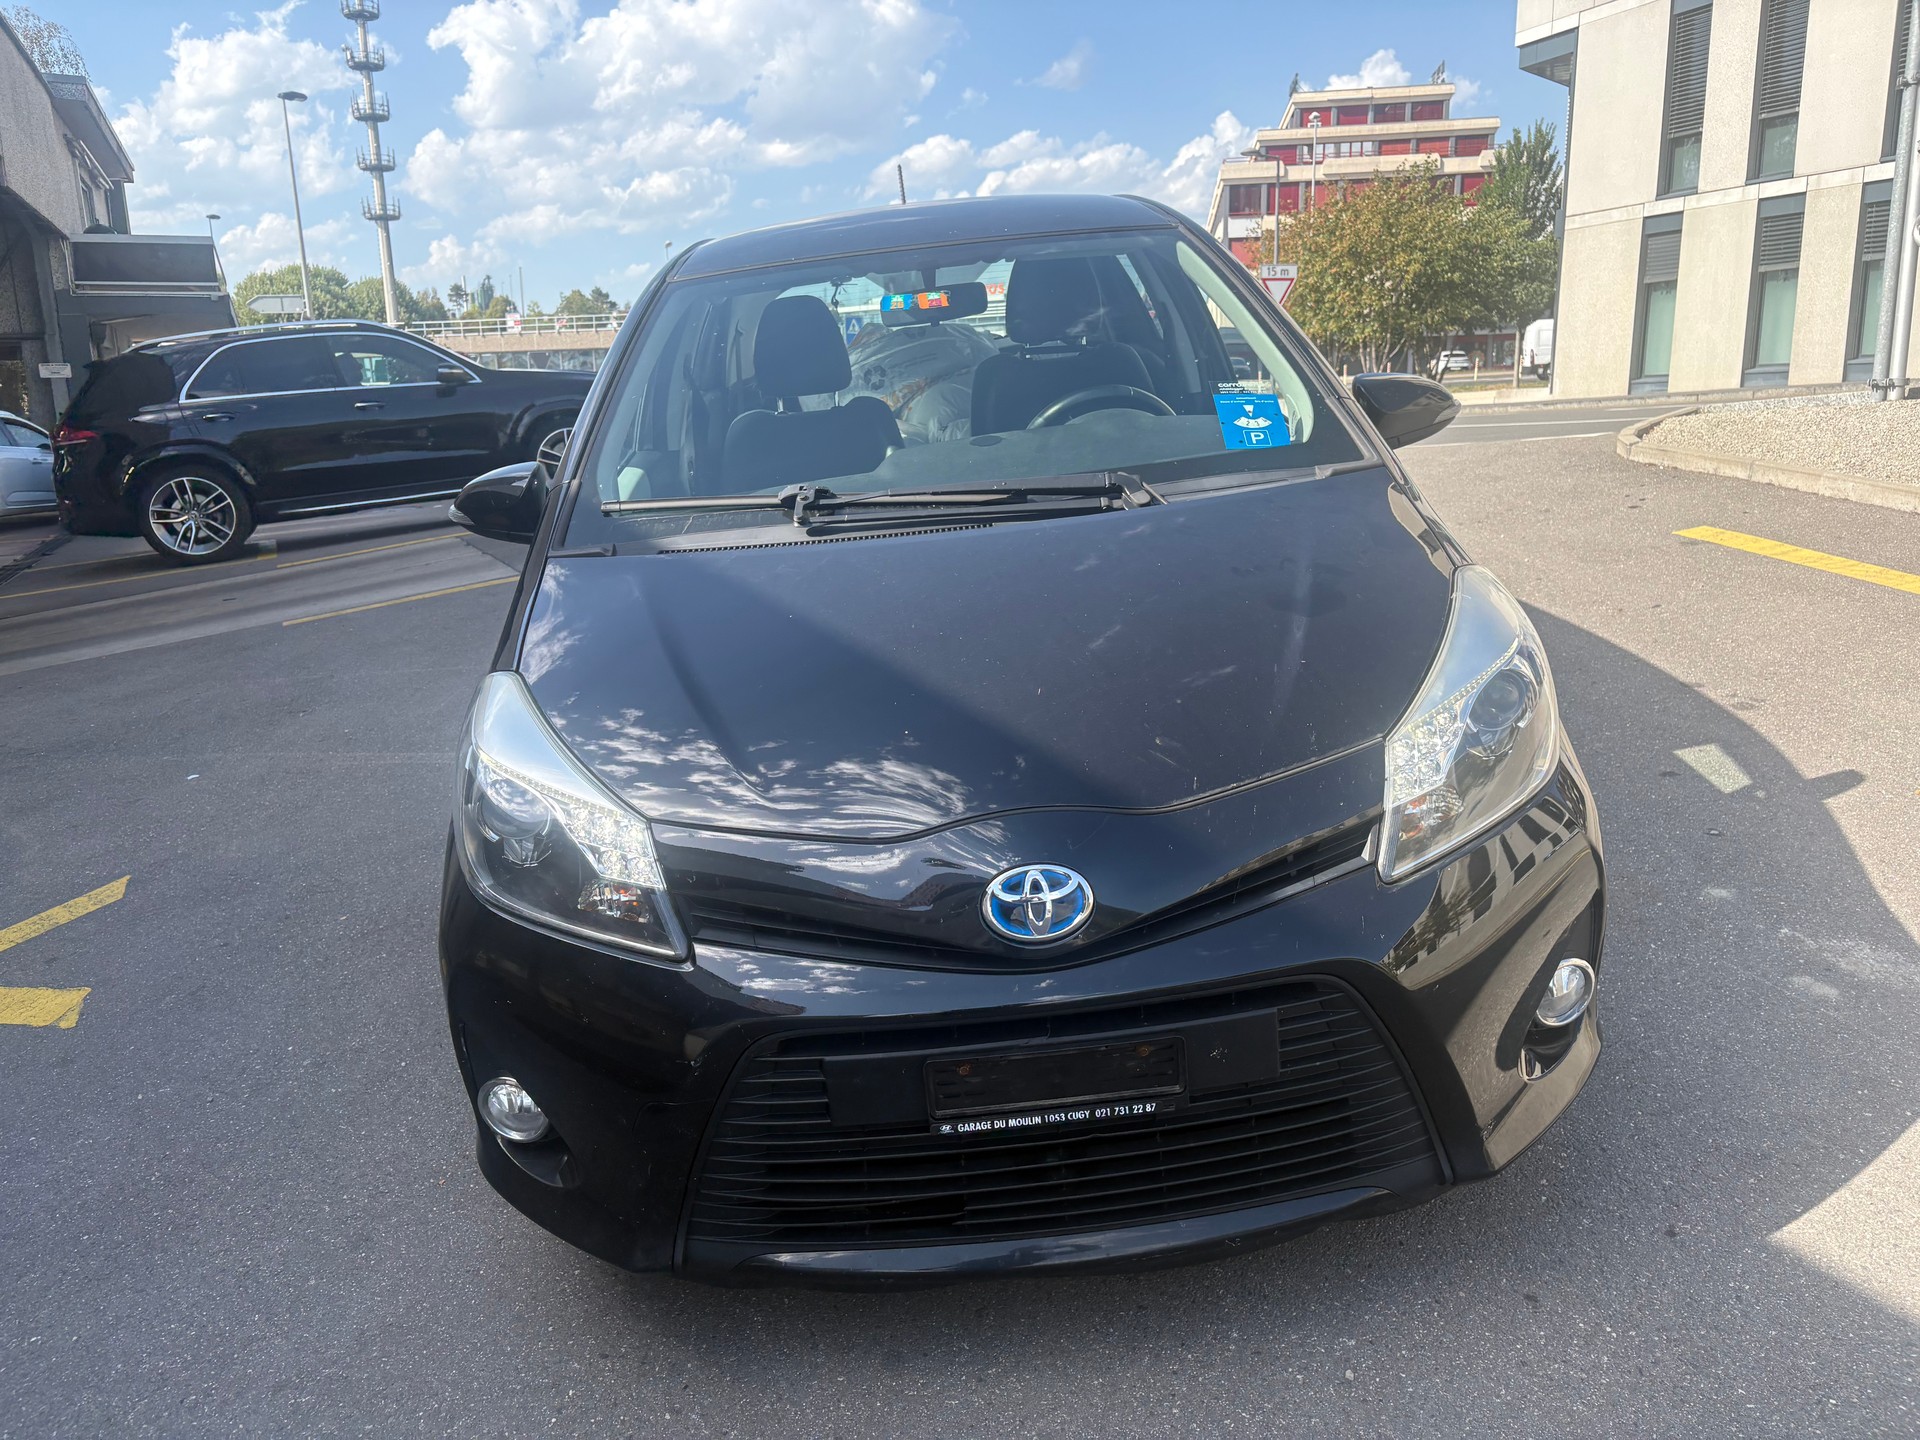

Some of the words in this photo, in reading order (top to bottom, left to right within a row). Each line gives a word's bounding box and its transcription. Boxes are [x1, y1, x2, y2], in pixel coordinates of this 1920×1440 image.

[1267, 266, 1277, 277] 15
[1280, 268, 1289, 276] m
[1250, 432, 1265, 445] P
[957, 1121, 992, 1132] GARAGE
[994, 1119, 1006, 1129] DU
[1008, 1115, 1042, 1128] MOULIN
[1044, 1113, 1066, 1123] 1053
[1067, 1109, 1091, 1121] CUGY
[1095, 1107, 1111, 1118] 021
[1114, 1105, 1130, 1116] 731
[1132, 1104, 1143, 1114] 22
[1145, 1102, 1157, 1112] 87
